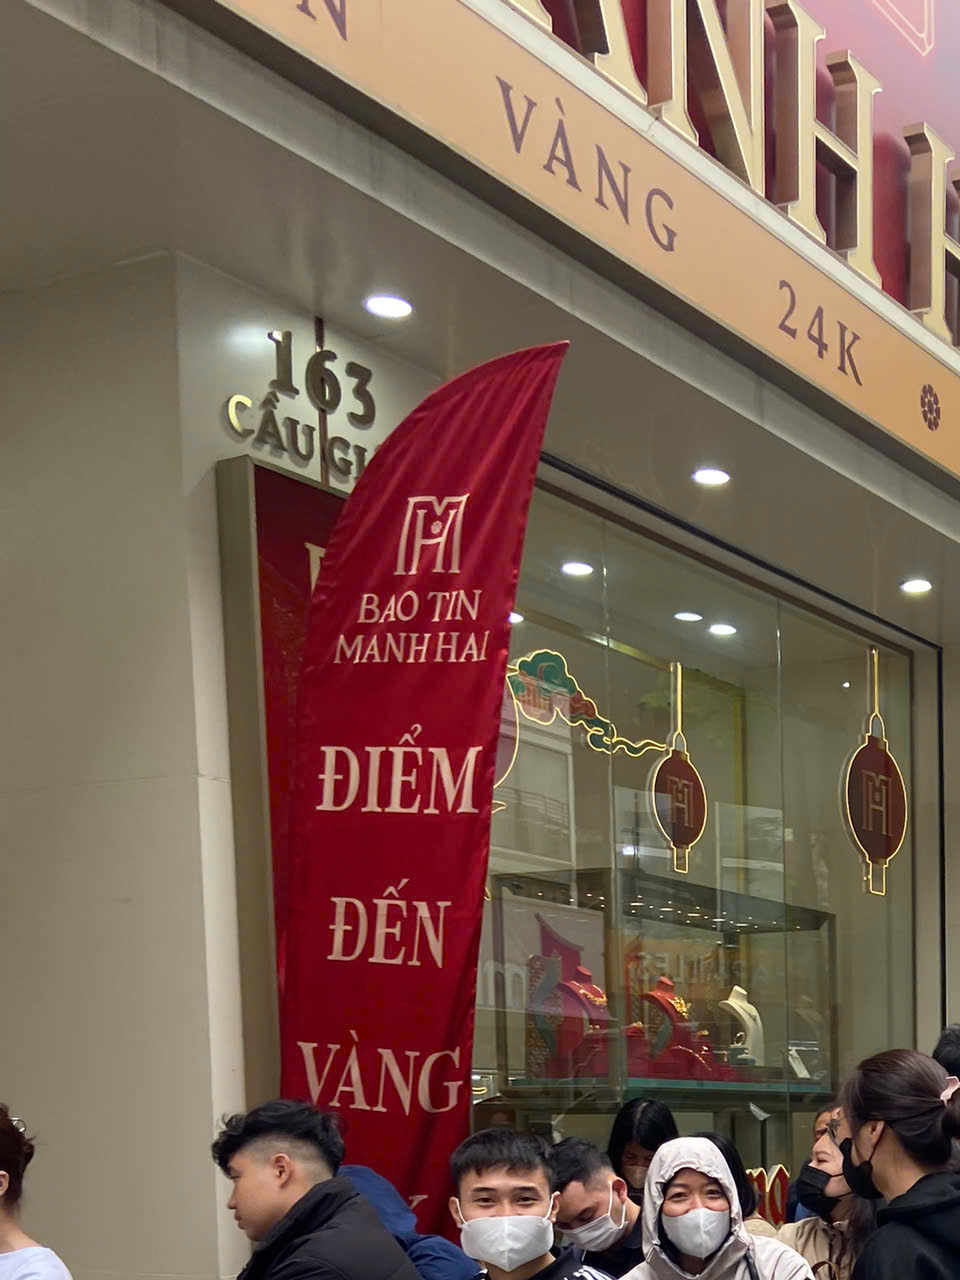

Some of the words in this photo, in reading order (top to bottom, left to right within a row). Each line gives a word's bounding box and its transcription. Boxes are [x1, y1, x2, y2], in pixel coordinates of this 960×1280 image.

[495, 75, 678, 253] VÀNG
[778, 279, 863, 387] 24K
[267, 330, 376, 431] 163
[333, 631, 432, 664] MANH
[433, 630, 490, 663] HAI
[357, 590, 420, 624] BAO
[427, 589, 482, 623] TIN
[315, 723, 483, 815] ĐIỂM
[326, 878, 453, 969] ĐẾN
[297, 1030, 464, 1116] VÀNG
